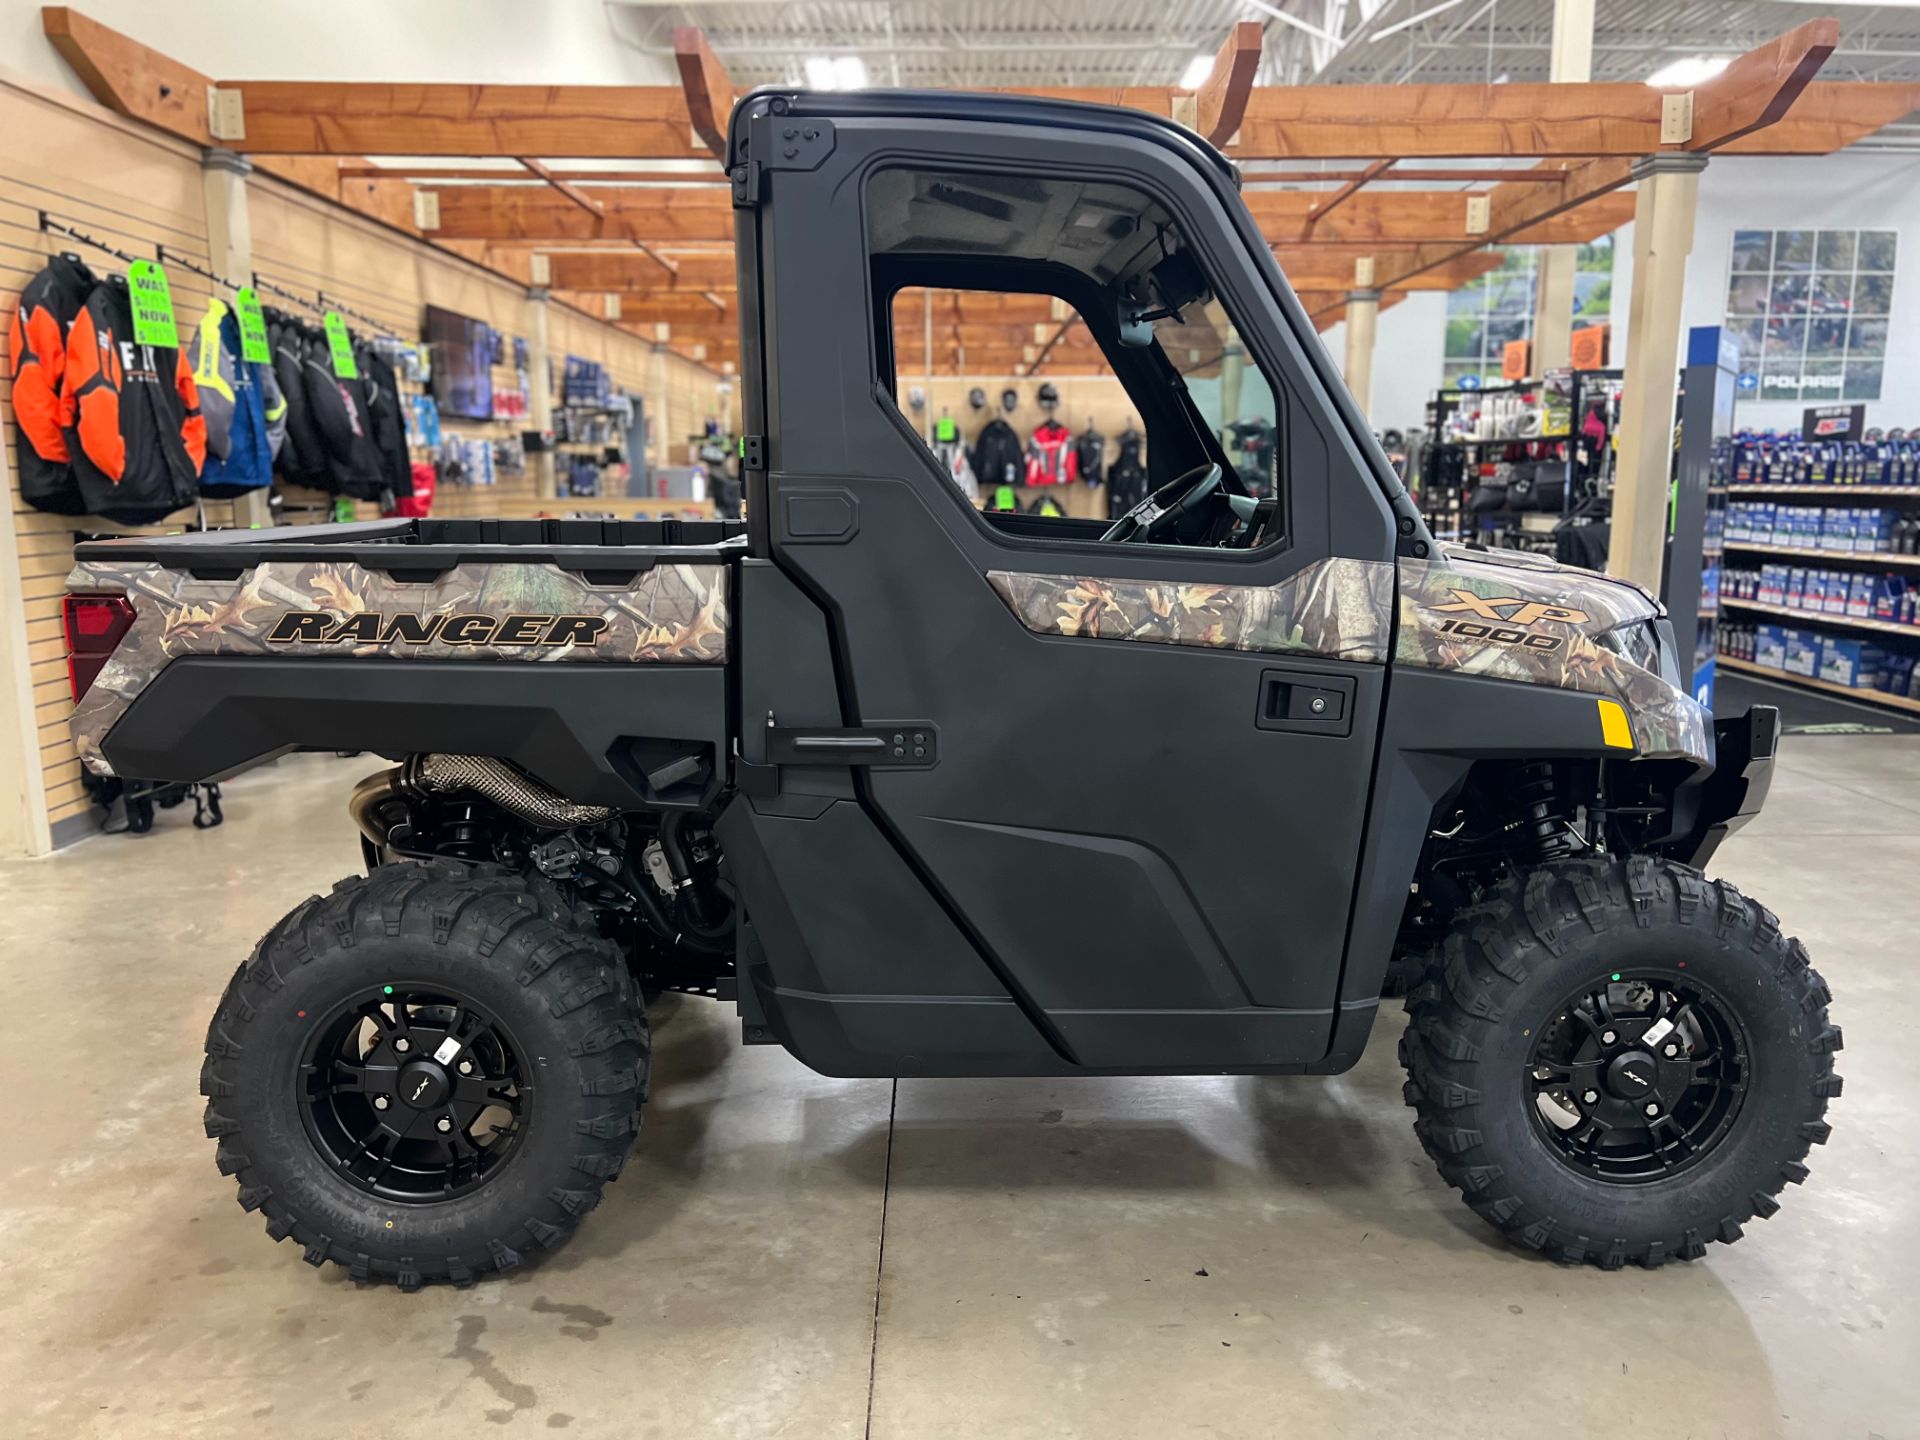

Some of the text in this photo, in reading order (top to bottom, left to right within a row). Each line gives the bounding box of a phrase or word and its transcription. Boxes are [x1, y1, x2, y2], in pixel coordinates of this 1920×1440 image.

[139, 308, 171, 324] NOW
[1764, 375, 1844, 388] POLARIS
[1427, 588, 1591, 626] XP
[266, 611, 608, 646] RANGER
[1439, 619, 1564, 651] 1000
